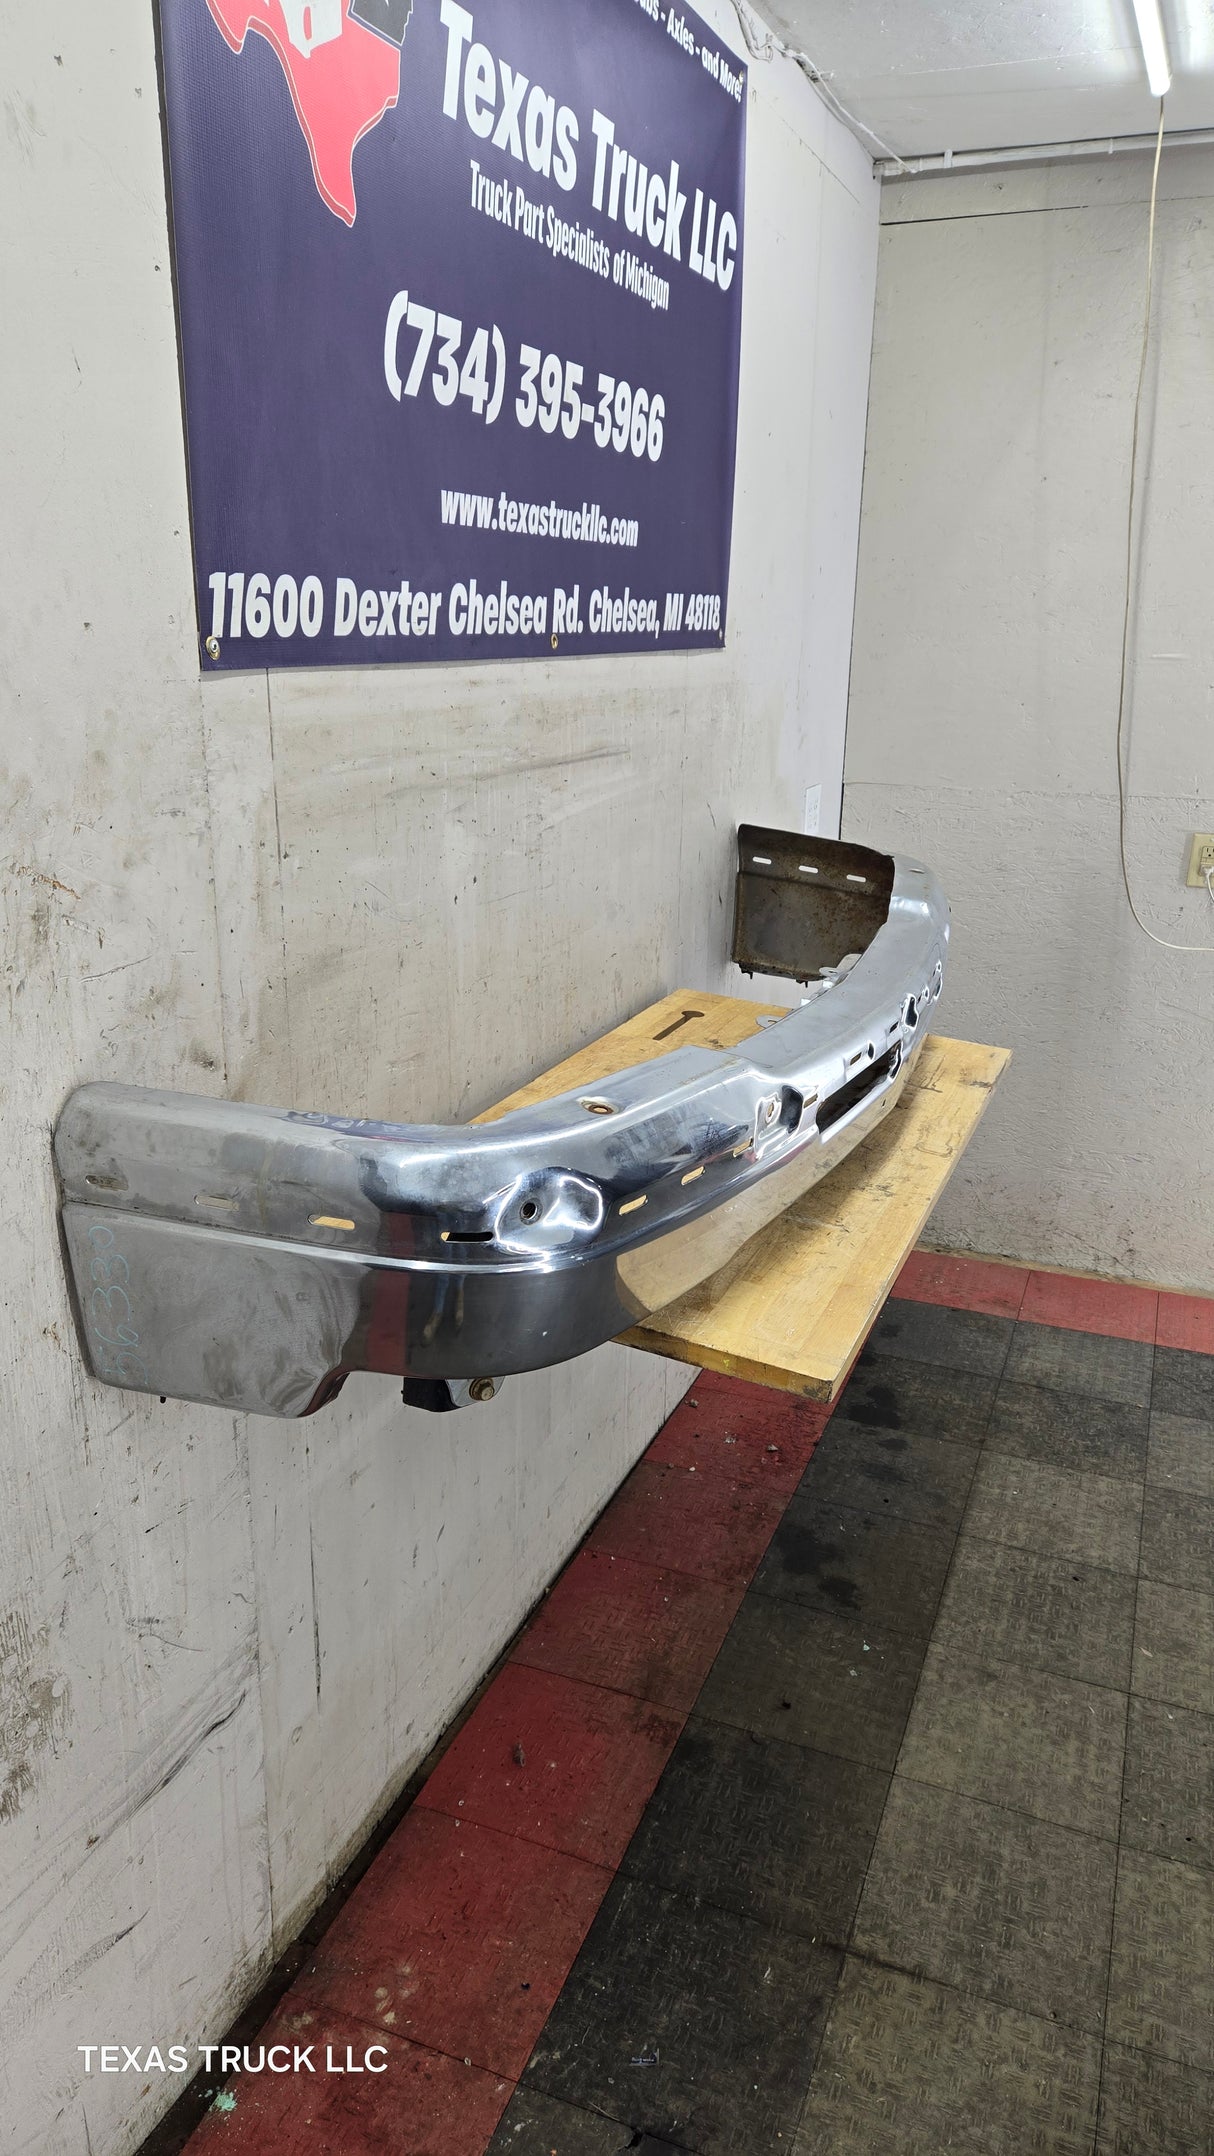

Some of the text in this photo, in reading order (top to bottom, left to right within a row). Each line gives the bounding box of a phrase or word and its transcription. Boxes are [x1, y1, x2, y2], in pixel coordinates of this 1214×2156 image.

[666, 8, 694, 55] Axles
[701, 46, 720, 80] and
[439, 0, 737, 291] Texas Truck LLC
[470, 159, 670, 311] Truck Part Specialists of Michigan
[384, 290, 666, 462] (734) 395-3966
[440, 489, 639, 547] www.texastruckllc.com
[208, 571, 721, 639] 11600 Dexter Chelsea Rd. Chelsea, MI 48118
